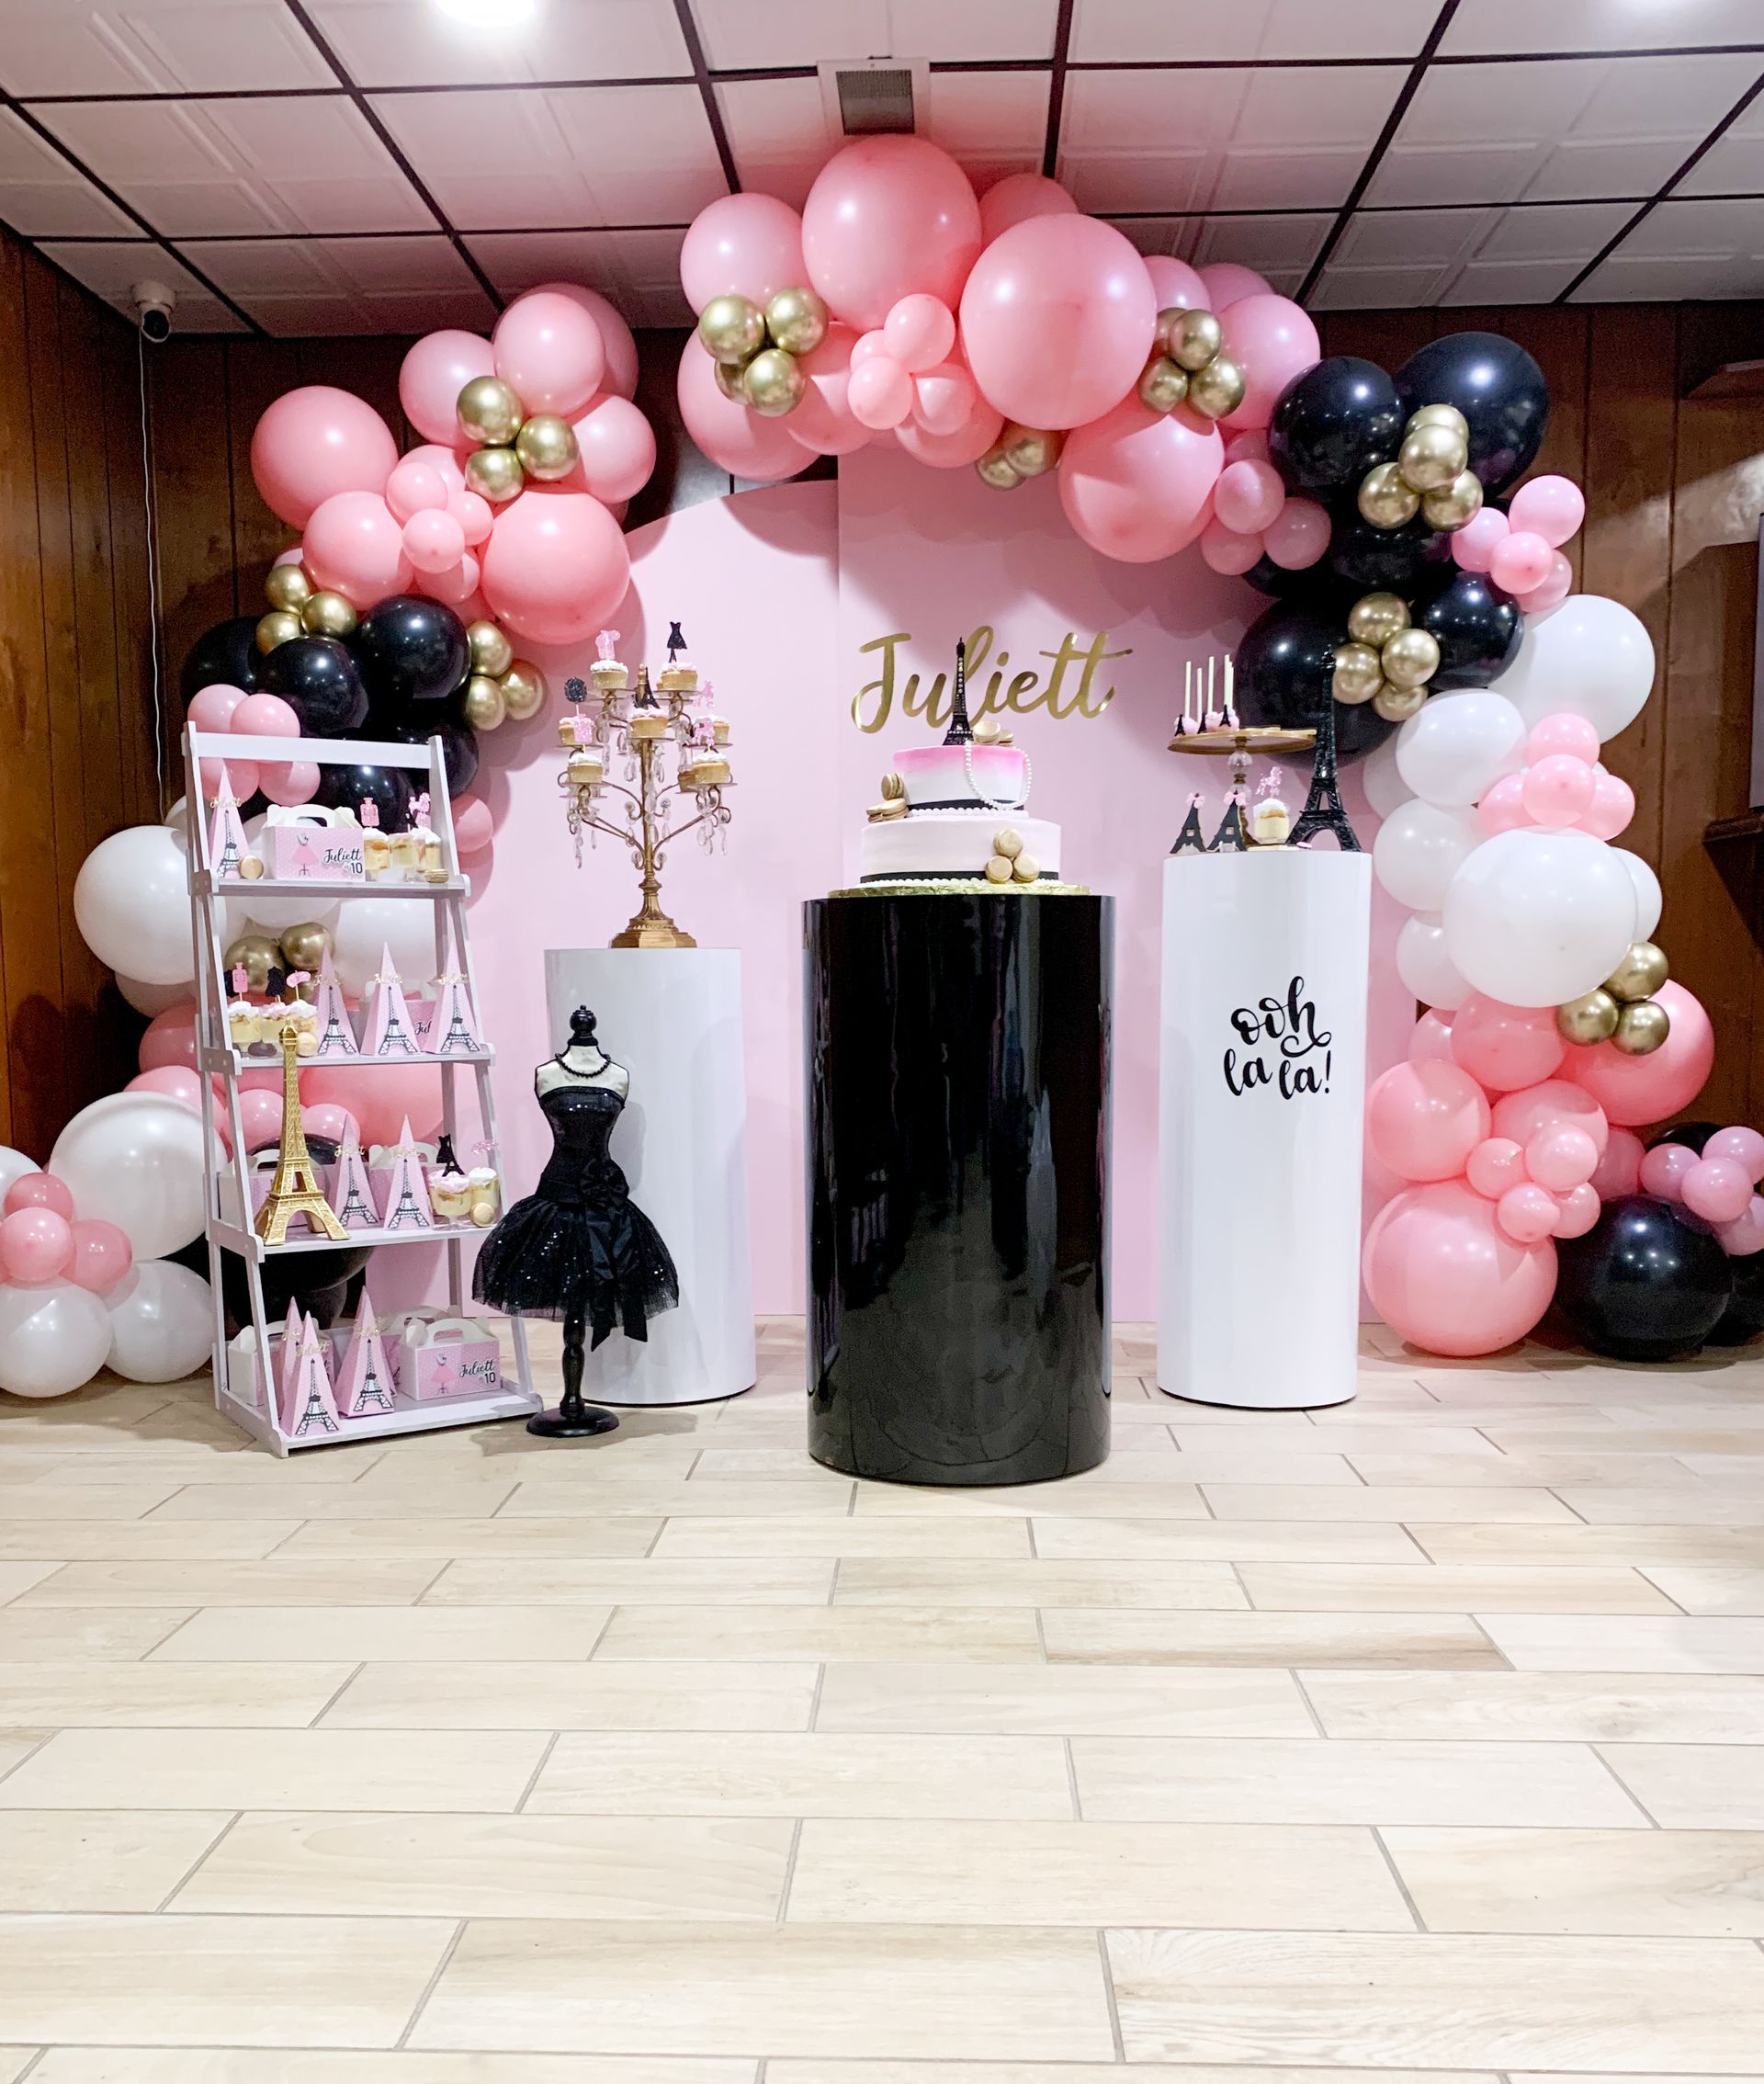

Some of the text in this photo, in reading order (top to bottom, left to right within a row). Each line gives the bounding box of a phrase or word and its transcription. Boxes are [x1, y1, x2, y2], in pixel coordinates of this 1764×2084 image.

[852, 625, 1134, 734] Juliett
[323, 846, 362, 863] Juliett
[351, 862, 363, 874] 10
[1230, 975, 1332, 1058] ooh
[1224, 1048, 1331, 1100] la la!
[459, 1358, 496, 1378] Juliett
[484, 1372, 496, 1384] 10
